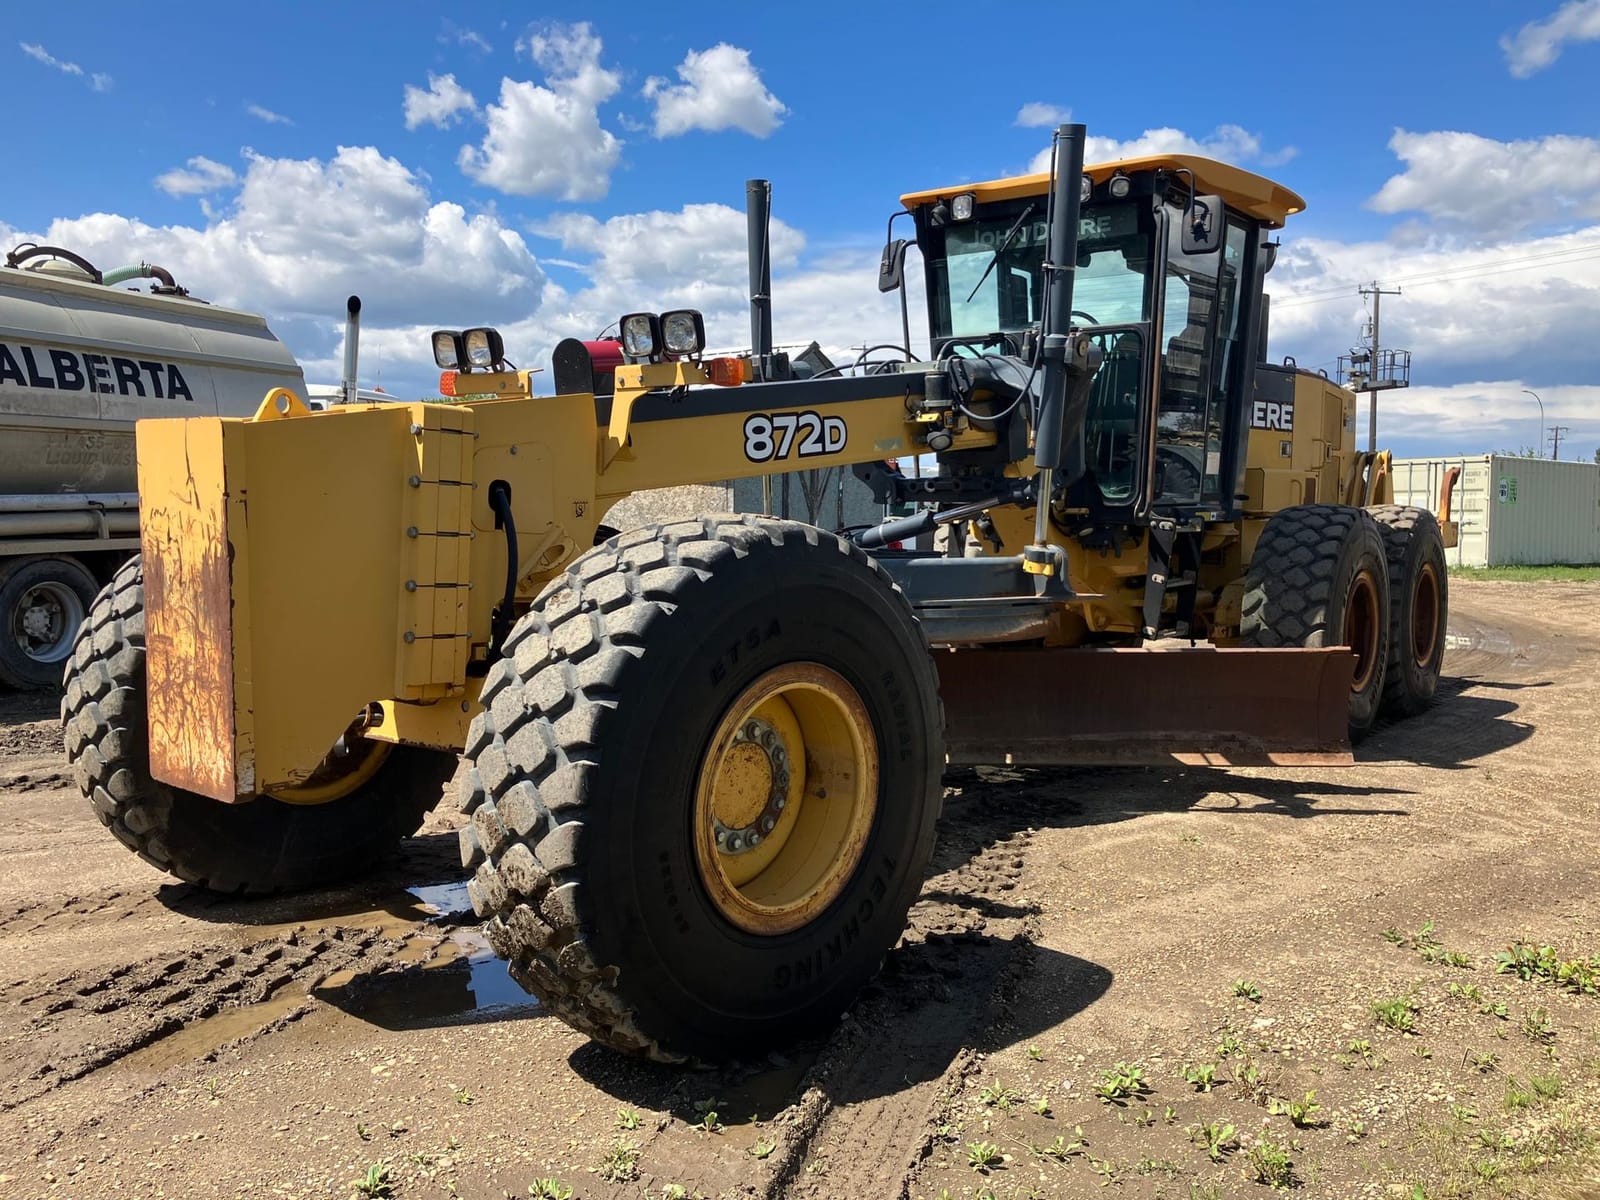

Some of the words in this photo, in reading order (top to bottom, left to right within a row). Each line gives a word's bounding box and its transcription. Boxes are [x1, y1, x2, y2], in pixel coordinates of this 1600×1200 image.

[1032, 215, 1112, 241] DRE
[0, 344, 193, 401] ALBERTA
[743, 410, 847, 463] 872D
[1250, 400, 1293, 431] ERE
[774, 855, 897, 988] TECHKING
